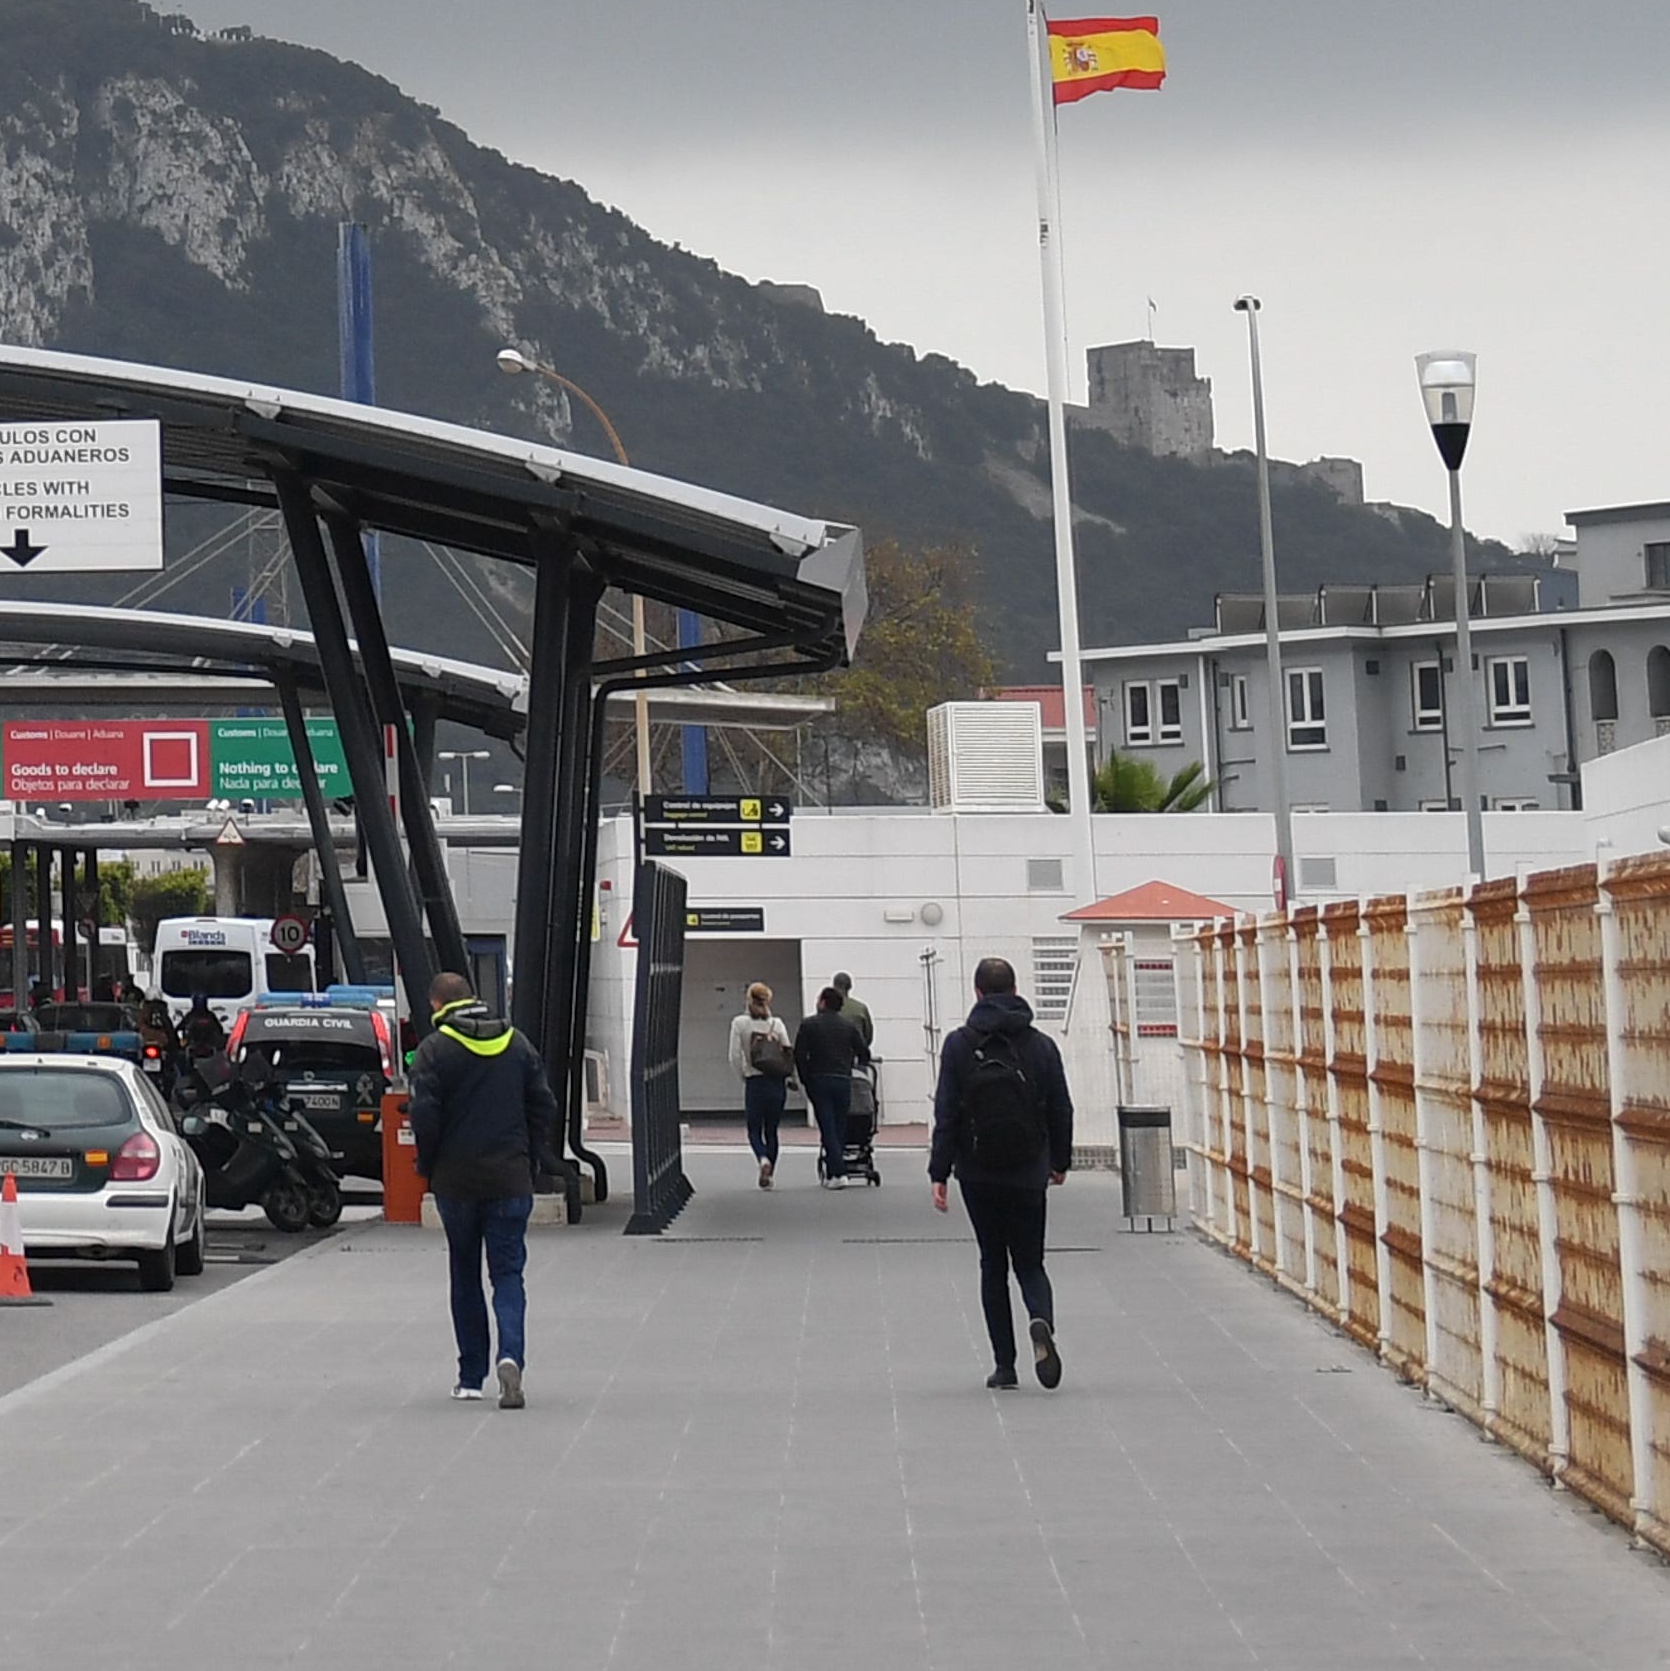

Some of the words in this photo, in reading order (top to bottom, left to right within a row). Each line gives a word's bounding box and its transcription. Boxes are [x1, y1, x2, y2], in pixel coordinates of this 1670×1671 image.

[56, 429, 96, 444] CON
[10, 448, 130, 464] ADUANEROS
[43, 481, 90, 495] WITH
[6, 503, 130, 519] FORMALITIES
[11, 762, 52, 776] Goods
[55, 764, 69, 776] to
[72, 762, 118, 775] declare
[220, 761, 271, 776] Nothing
[274, 762, 288, 774] to
[11, 778, 55, 793] Objetos
[58, 780, 82, 793] para
[86, 777, 130, 790] declarar
[220, 777, 250, 789] Nada
[253, 779, 278, 791] para
[188, 930, 226, 941] Blands
[280, 926, 300, 942] 10
[264, 1018, 319, 1028] GUARDIA
[322, 1018, 353, 1029] CIVIL
[22, 1159, 58, 1175] 5847
